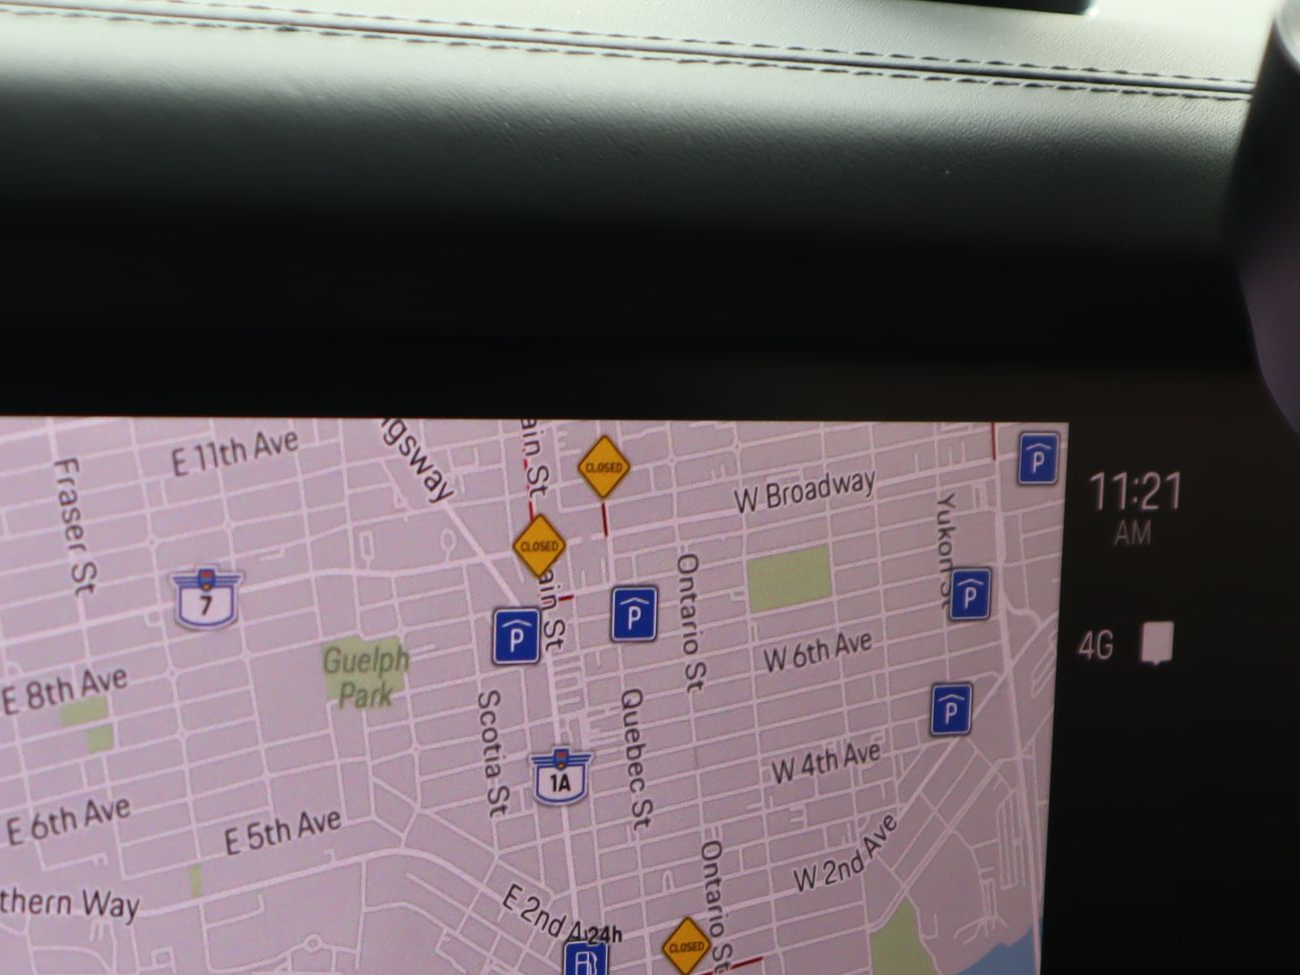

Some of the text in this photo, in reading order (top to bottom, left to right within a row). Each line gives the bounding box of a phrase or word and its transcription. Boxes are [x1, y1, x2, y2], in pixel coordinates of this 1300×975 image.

[170, 430, 299, 476] E 11th Ave
[585, 462, 623, 473] CLOSED
[527, 466, 549, 498] St
[734, 470, 876, 515] W Broadway
[1090, 471, 1181, 511] 11:21
[54, 457, 98, 597] Fraser St
[521, 541, 559, 552] CLOSED
[938, 493, 956, 573] Yukon
[1114, 520, 1152, 545] AM
[198, 595, 212, 616] 7
[677, 554, 707, 694] Ontario St
[544, 620, 565, 652] St
[764, 629, 873, 673] W 6th Ave
[1078, 630, 1113, 660] 4G
[323, 645, 410, 678] Guelph
[1, 666, 128, 717] E 8th Ave
[339, 681, 393, 709] Park
[478, 690, 509, 817] Scotia St
[621, 688, 654, 830] Quebec St
[772, 740, 881, 784] W 4th Ave
[551, 774, 571, 793] 1A
[6, 796, 131, 846] E 6th Ave
[224, 808, 343, 856] E 5th Ave
[793, 812, 899, 893] W 2nd Ave
[82, 890, 140, 925] Way
[502, 884, 523, 911] E
[521, 896, 567, 938] 2nd
[700, 839, 734, 974] Ontario St
[587, 926, 622, 945] 24h
[669, 942, 704, 953] CLOSED
